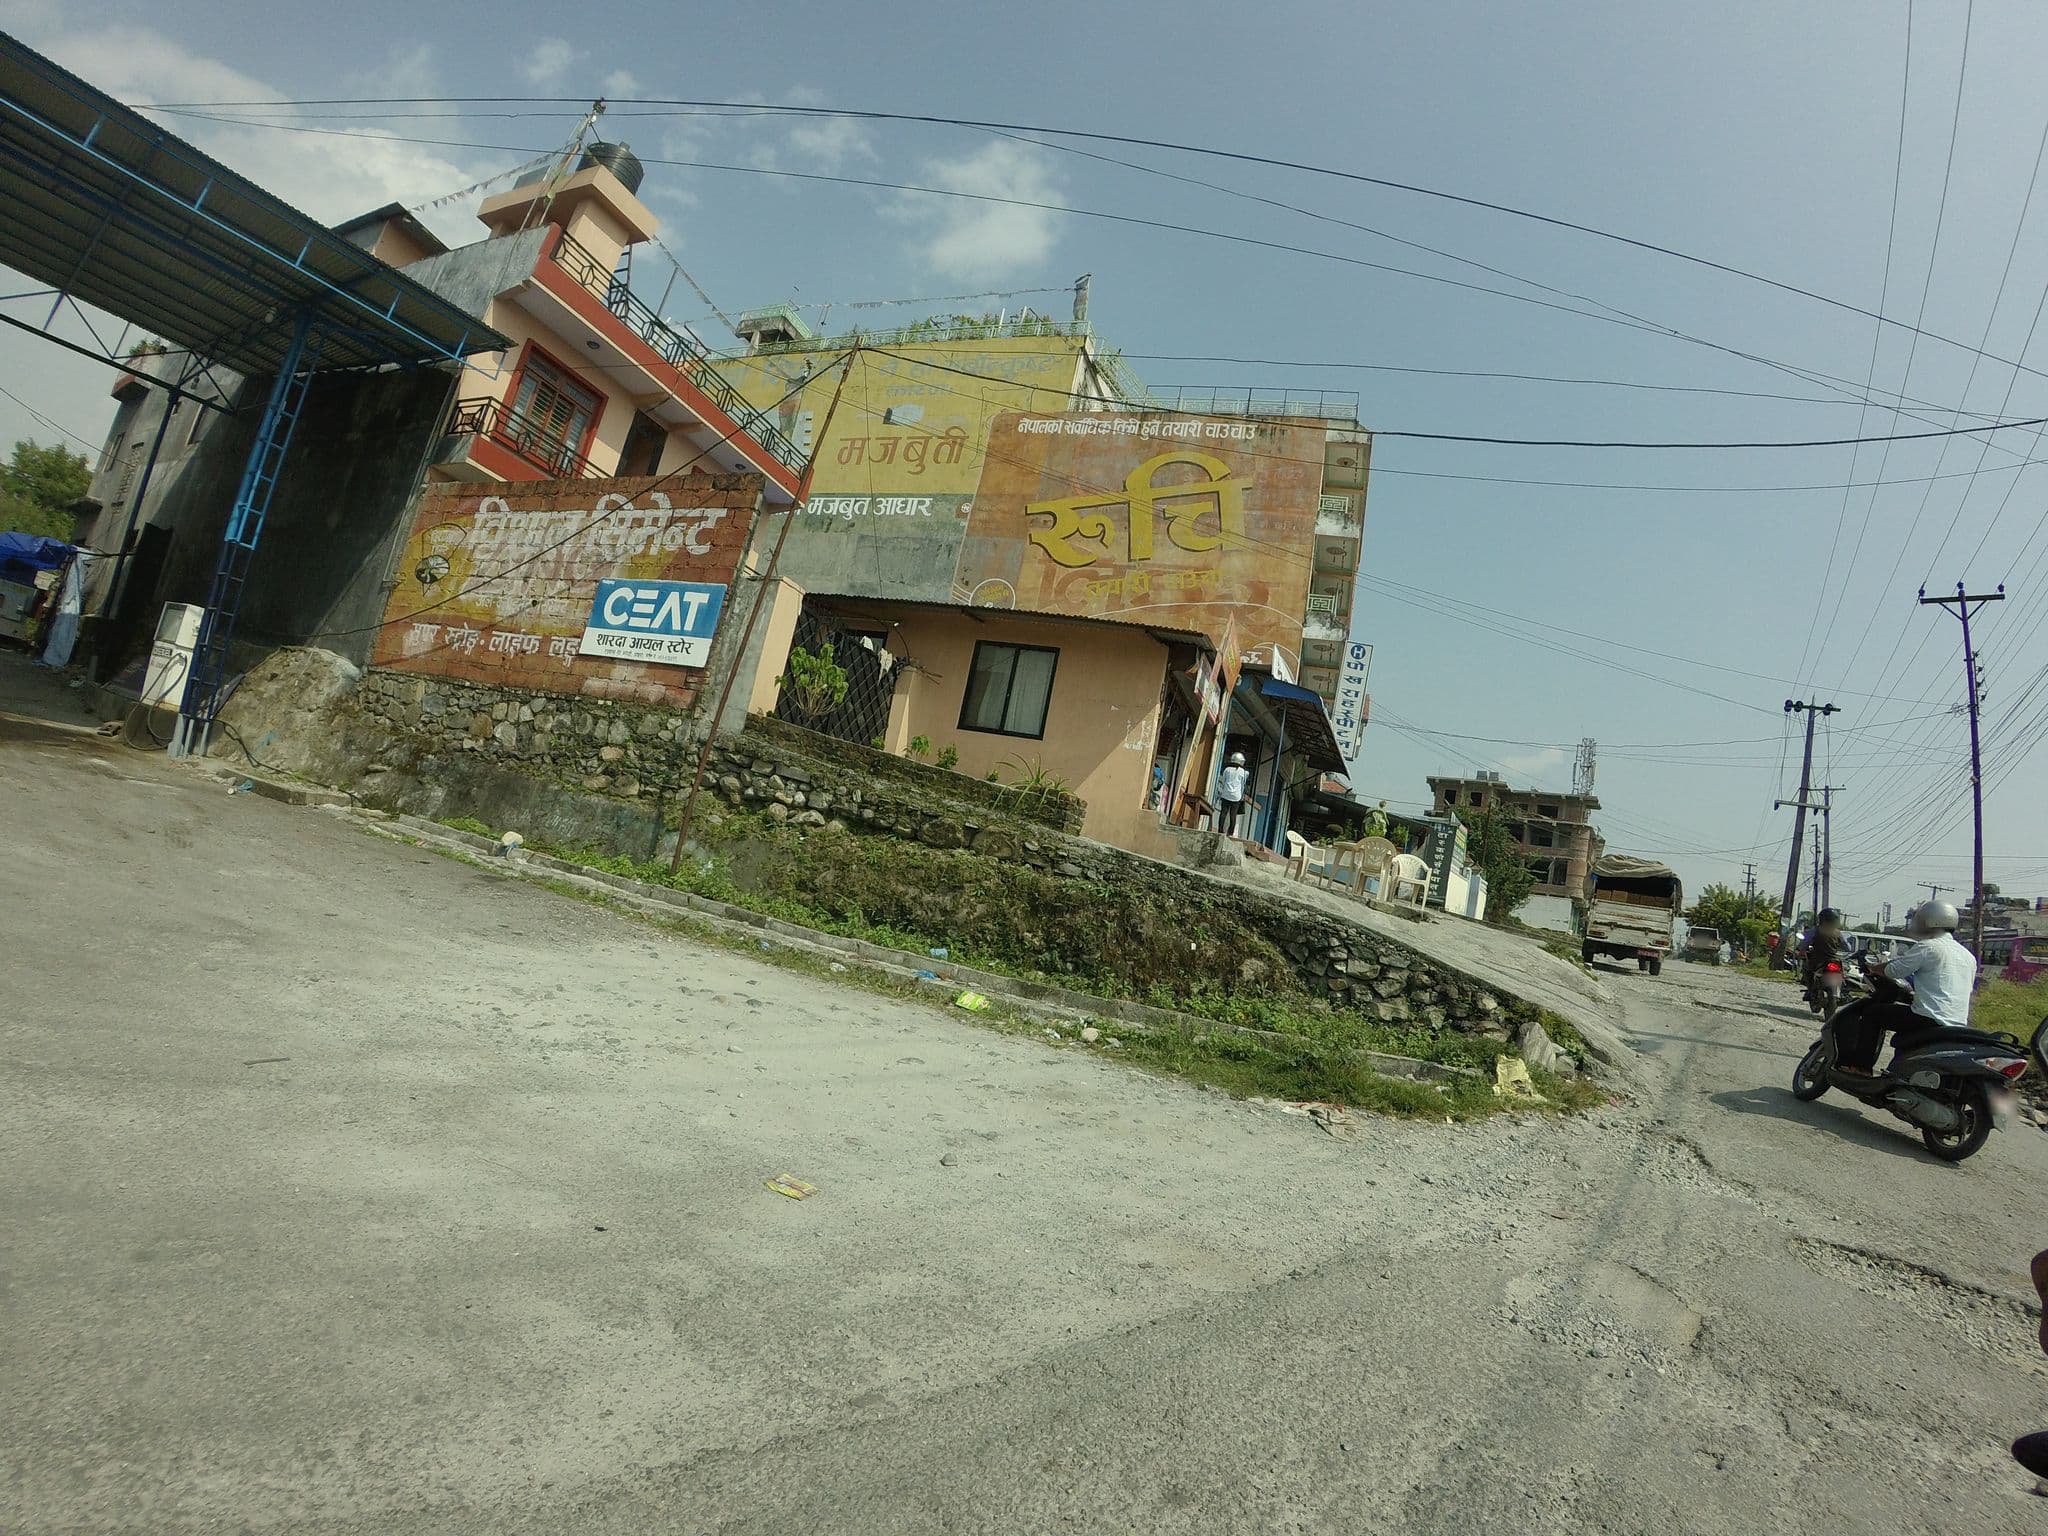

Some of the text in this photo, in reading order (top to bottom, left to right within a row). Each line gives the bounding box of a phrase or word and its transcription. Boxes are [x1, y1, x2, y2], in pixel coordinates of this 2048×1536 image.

[808, 497, 933, 520] मजबुत आधार
[604, 587, 710, 631] CEAT
[596, 633, 694, 654] शारदा आयल स्टोर
